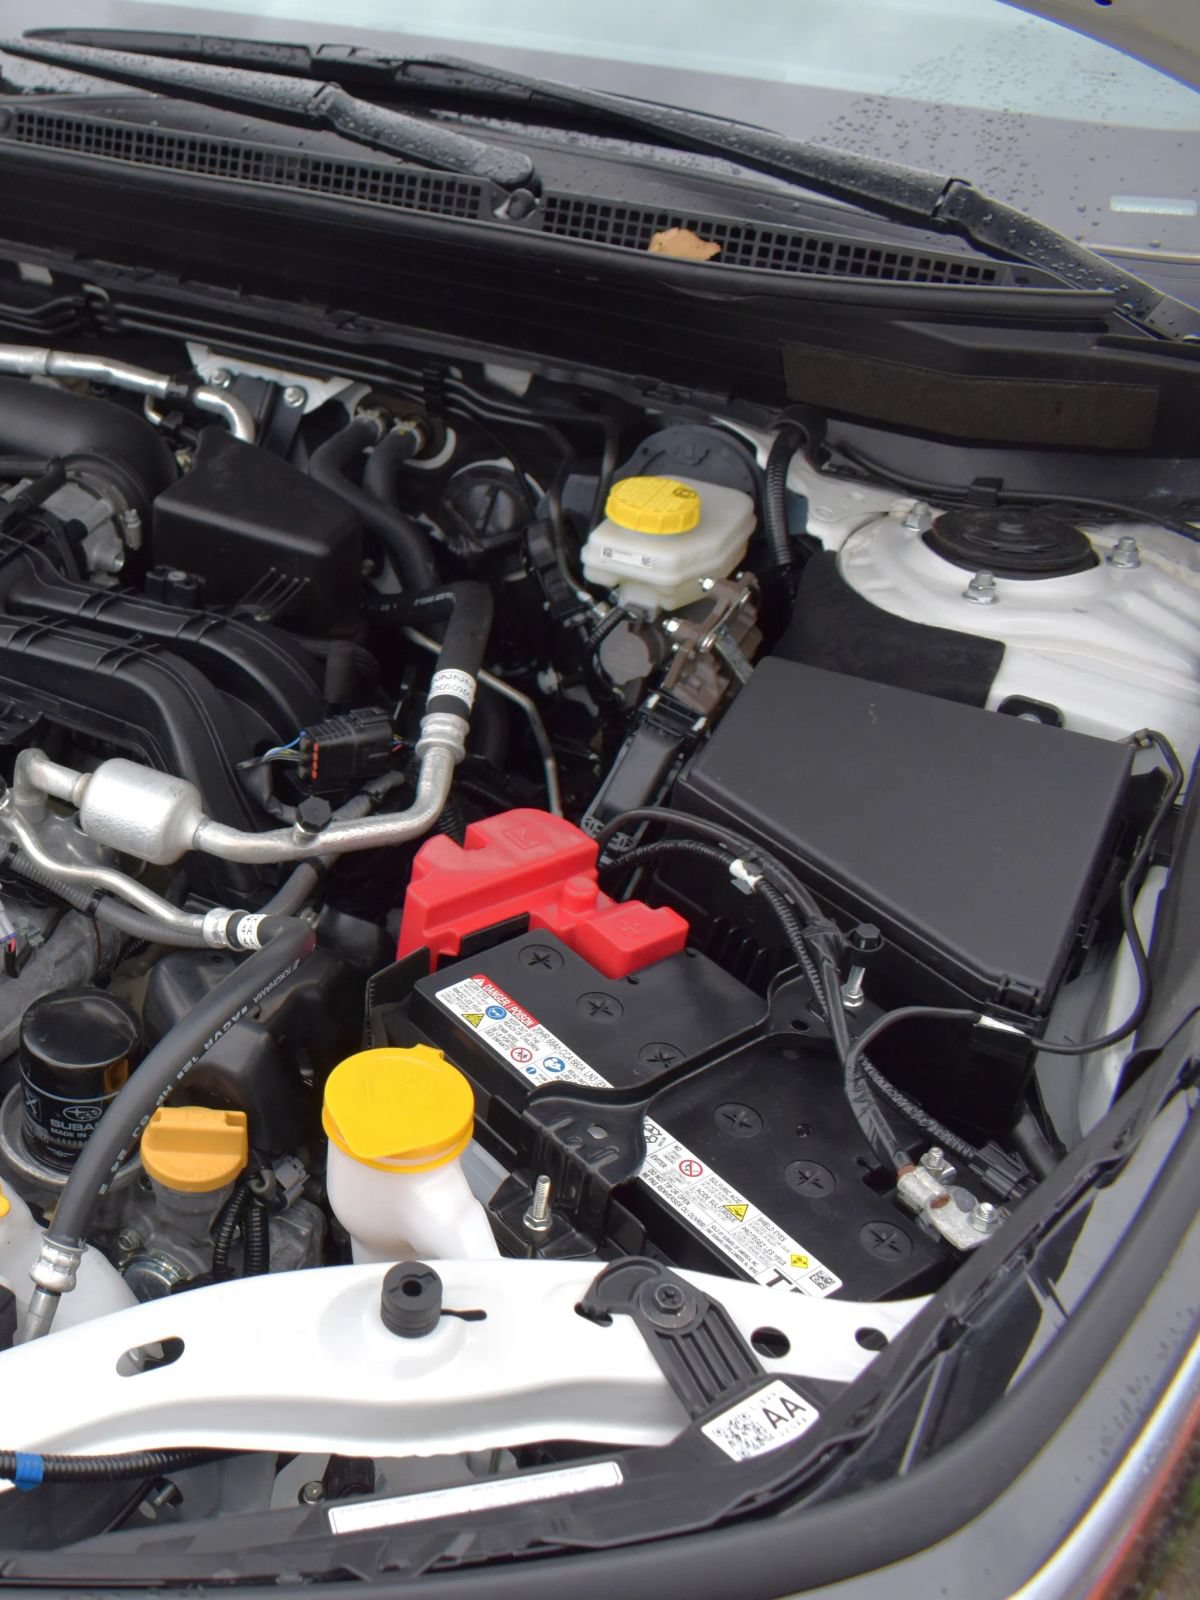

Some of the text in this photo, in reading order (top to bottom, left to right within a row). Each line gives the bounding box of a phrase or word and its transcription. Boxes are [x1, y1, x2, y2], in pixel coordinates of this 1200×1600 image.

[482, 984, 510, 1005] DANGER
[507, 1006, 535, 1026] POISON
[558, 1049, 574, 1061] CCA
[50, 1119, 96, 1131] SUBA
[51, 1128, 75, 1137] MADE
[762, 1396, 806, 1429] AA
